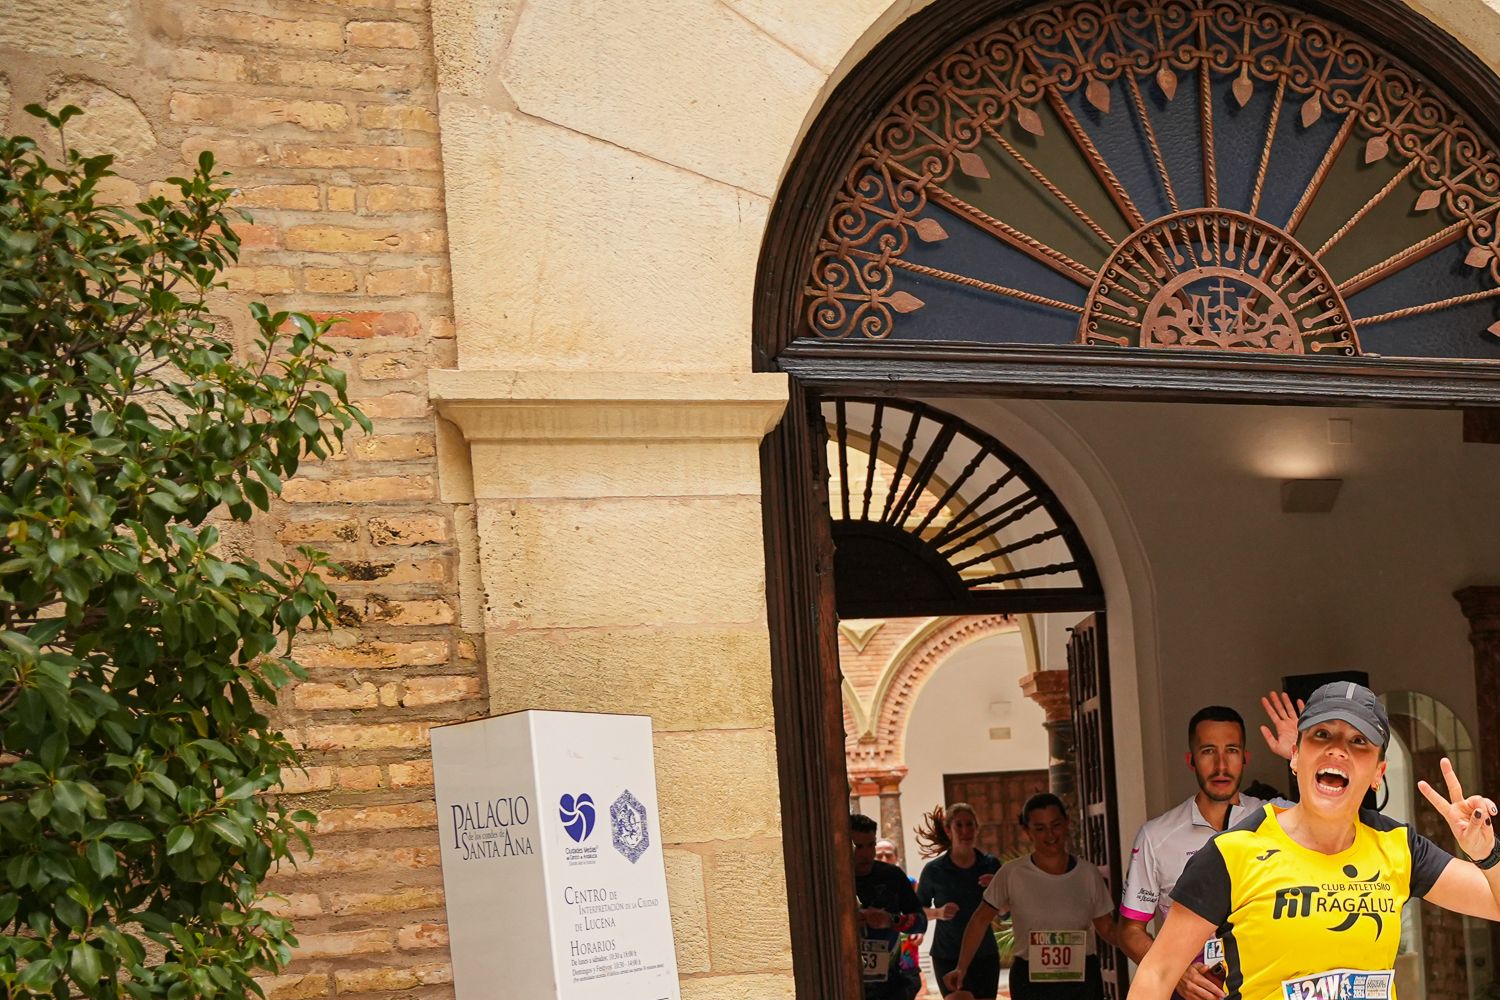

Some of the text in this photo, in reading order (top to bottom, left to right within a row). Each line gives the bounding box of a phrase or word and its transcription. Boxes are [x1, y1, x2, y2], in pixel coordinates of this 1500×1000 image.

[451, 796, 529, 849] PALACIO
[461, 828, 533, 860] SANTA ANA
[564, 886, 607, 905] CENTRO
[1321, 883, 1346, 891] CLUB
[1316, 897, 1396, 913] RAGALUZ
[584, 916, 616, 931] LUCENA
[571, 939, 616, 956] HORARIOS
[1041, 946, 1072, 966] 530
